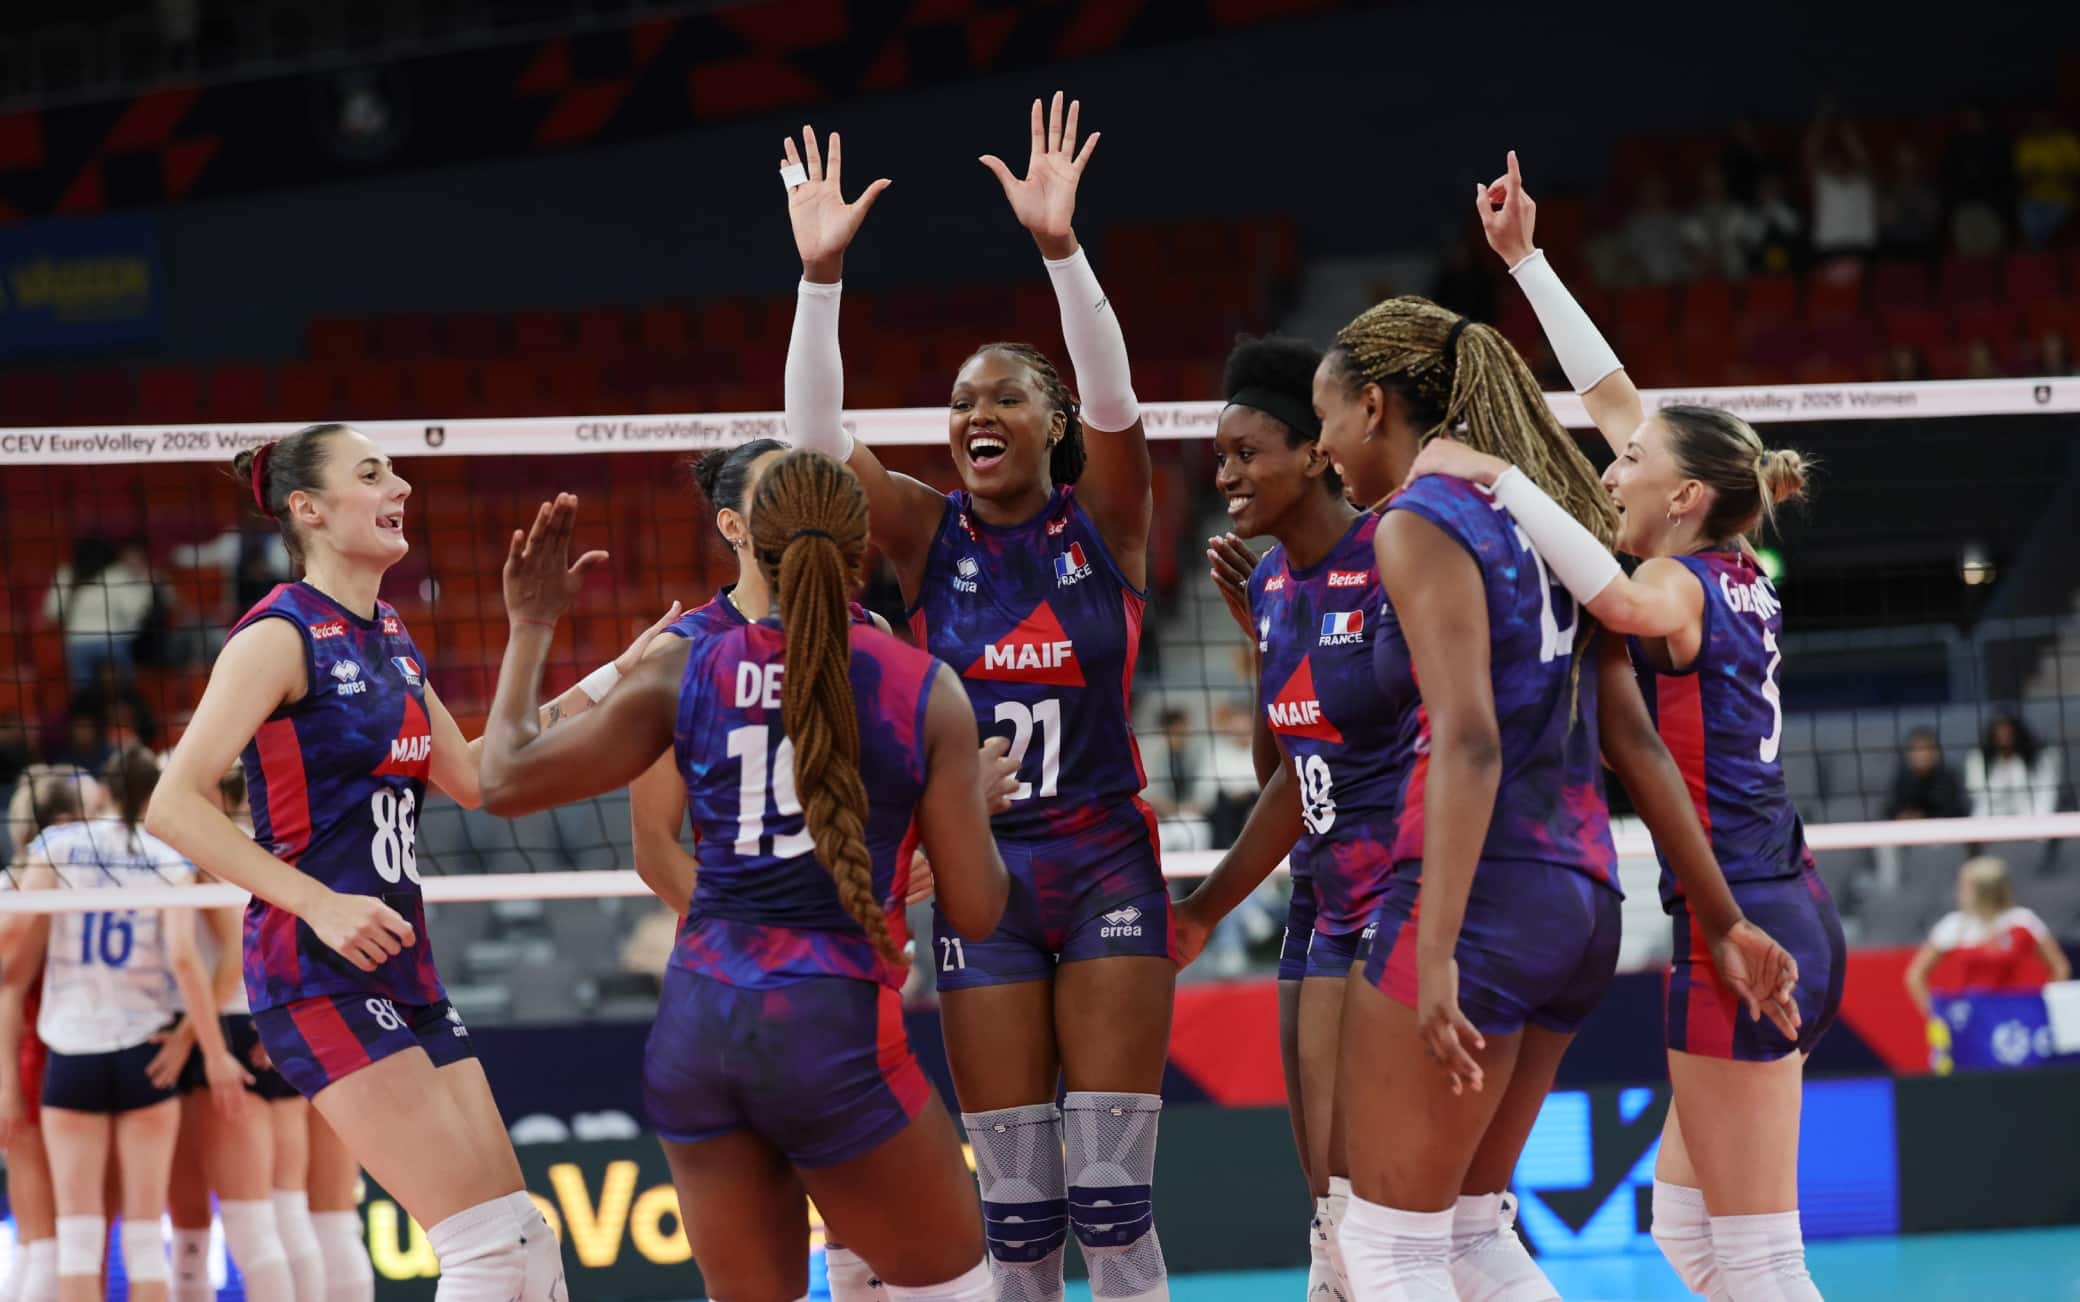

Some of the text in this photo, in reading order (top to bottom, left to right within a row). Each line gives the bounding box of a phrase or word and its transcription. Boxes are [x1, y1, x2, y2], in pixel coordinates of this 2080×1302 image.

[1801, 390, 1843, 408] 2026
[1847, 388, 1917, 407] Women
[1, 434, 44, 452] CEV
[50, 431, 156, 455] EuroVolley
[162, 431, 209, 450] 2026
[576, 422, 617, 441] CEV
[623, 420, 722, 441] EuroVolley
[731, 419, 776, 437] 2026
[1319, 633, 1364, 647] FRANCE
[984, 640, 1073, 671] MAIF
[337, 681, 367, 696] errea
[1267, 700, 1321, 728] MAIF
[390, 735, 432, 764] MAIF
[994, 698, 1062, 801] 21
[81, 909, 134, 969] 16
[1100, 924, 1142, 938] errea
[940, 936, 966, 972] 21
